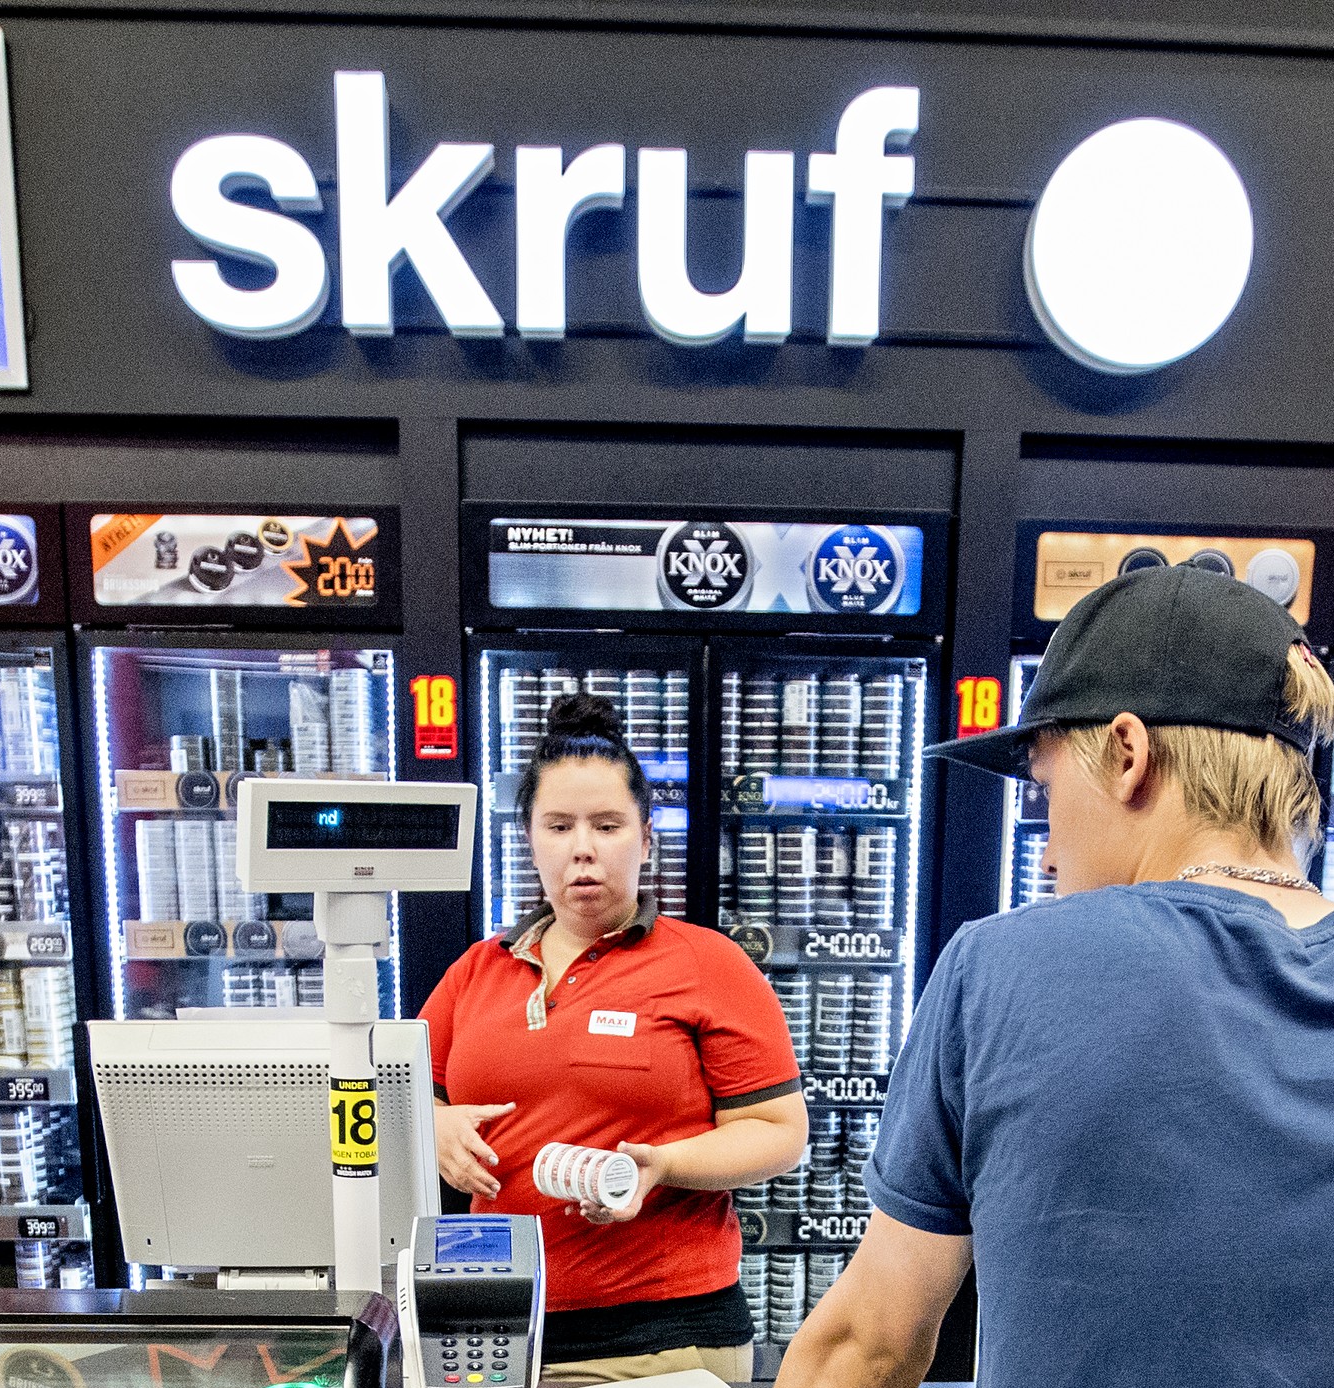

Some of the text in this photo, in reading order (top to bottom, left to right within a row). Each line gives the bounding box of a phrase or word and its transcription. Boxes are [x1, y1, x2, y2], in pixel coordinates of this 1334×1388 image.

[169, 70, 920, 344] skruf
[507, 526, 574, 542] NYHET!
[693, 530, 720, 539] SLIM
[843, 536, 870, 545] SLIM
[588, 541, 614, 552] FRÅN
[616, 544, 642, 553] KNOX
[669, 553, 742, 578] KNOX
[817, 557, 891, 583] KNOX
[411, 675, 457, 728] 18
[956, 677, 1002, 728] 18
[317, 808, 339, 826] nd
[596, 1014, 629, 1027] MAXI
[338, 1081, 369, 1089] UNDER
[332, 1098, 377, 1146] 18
